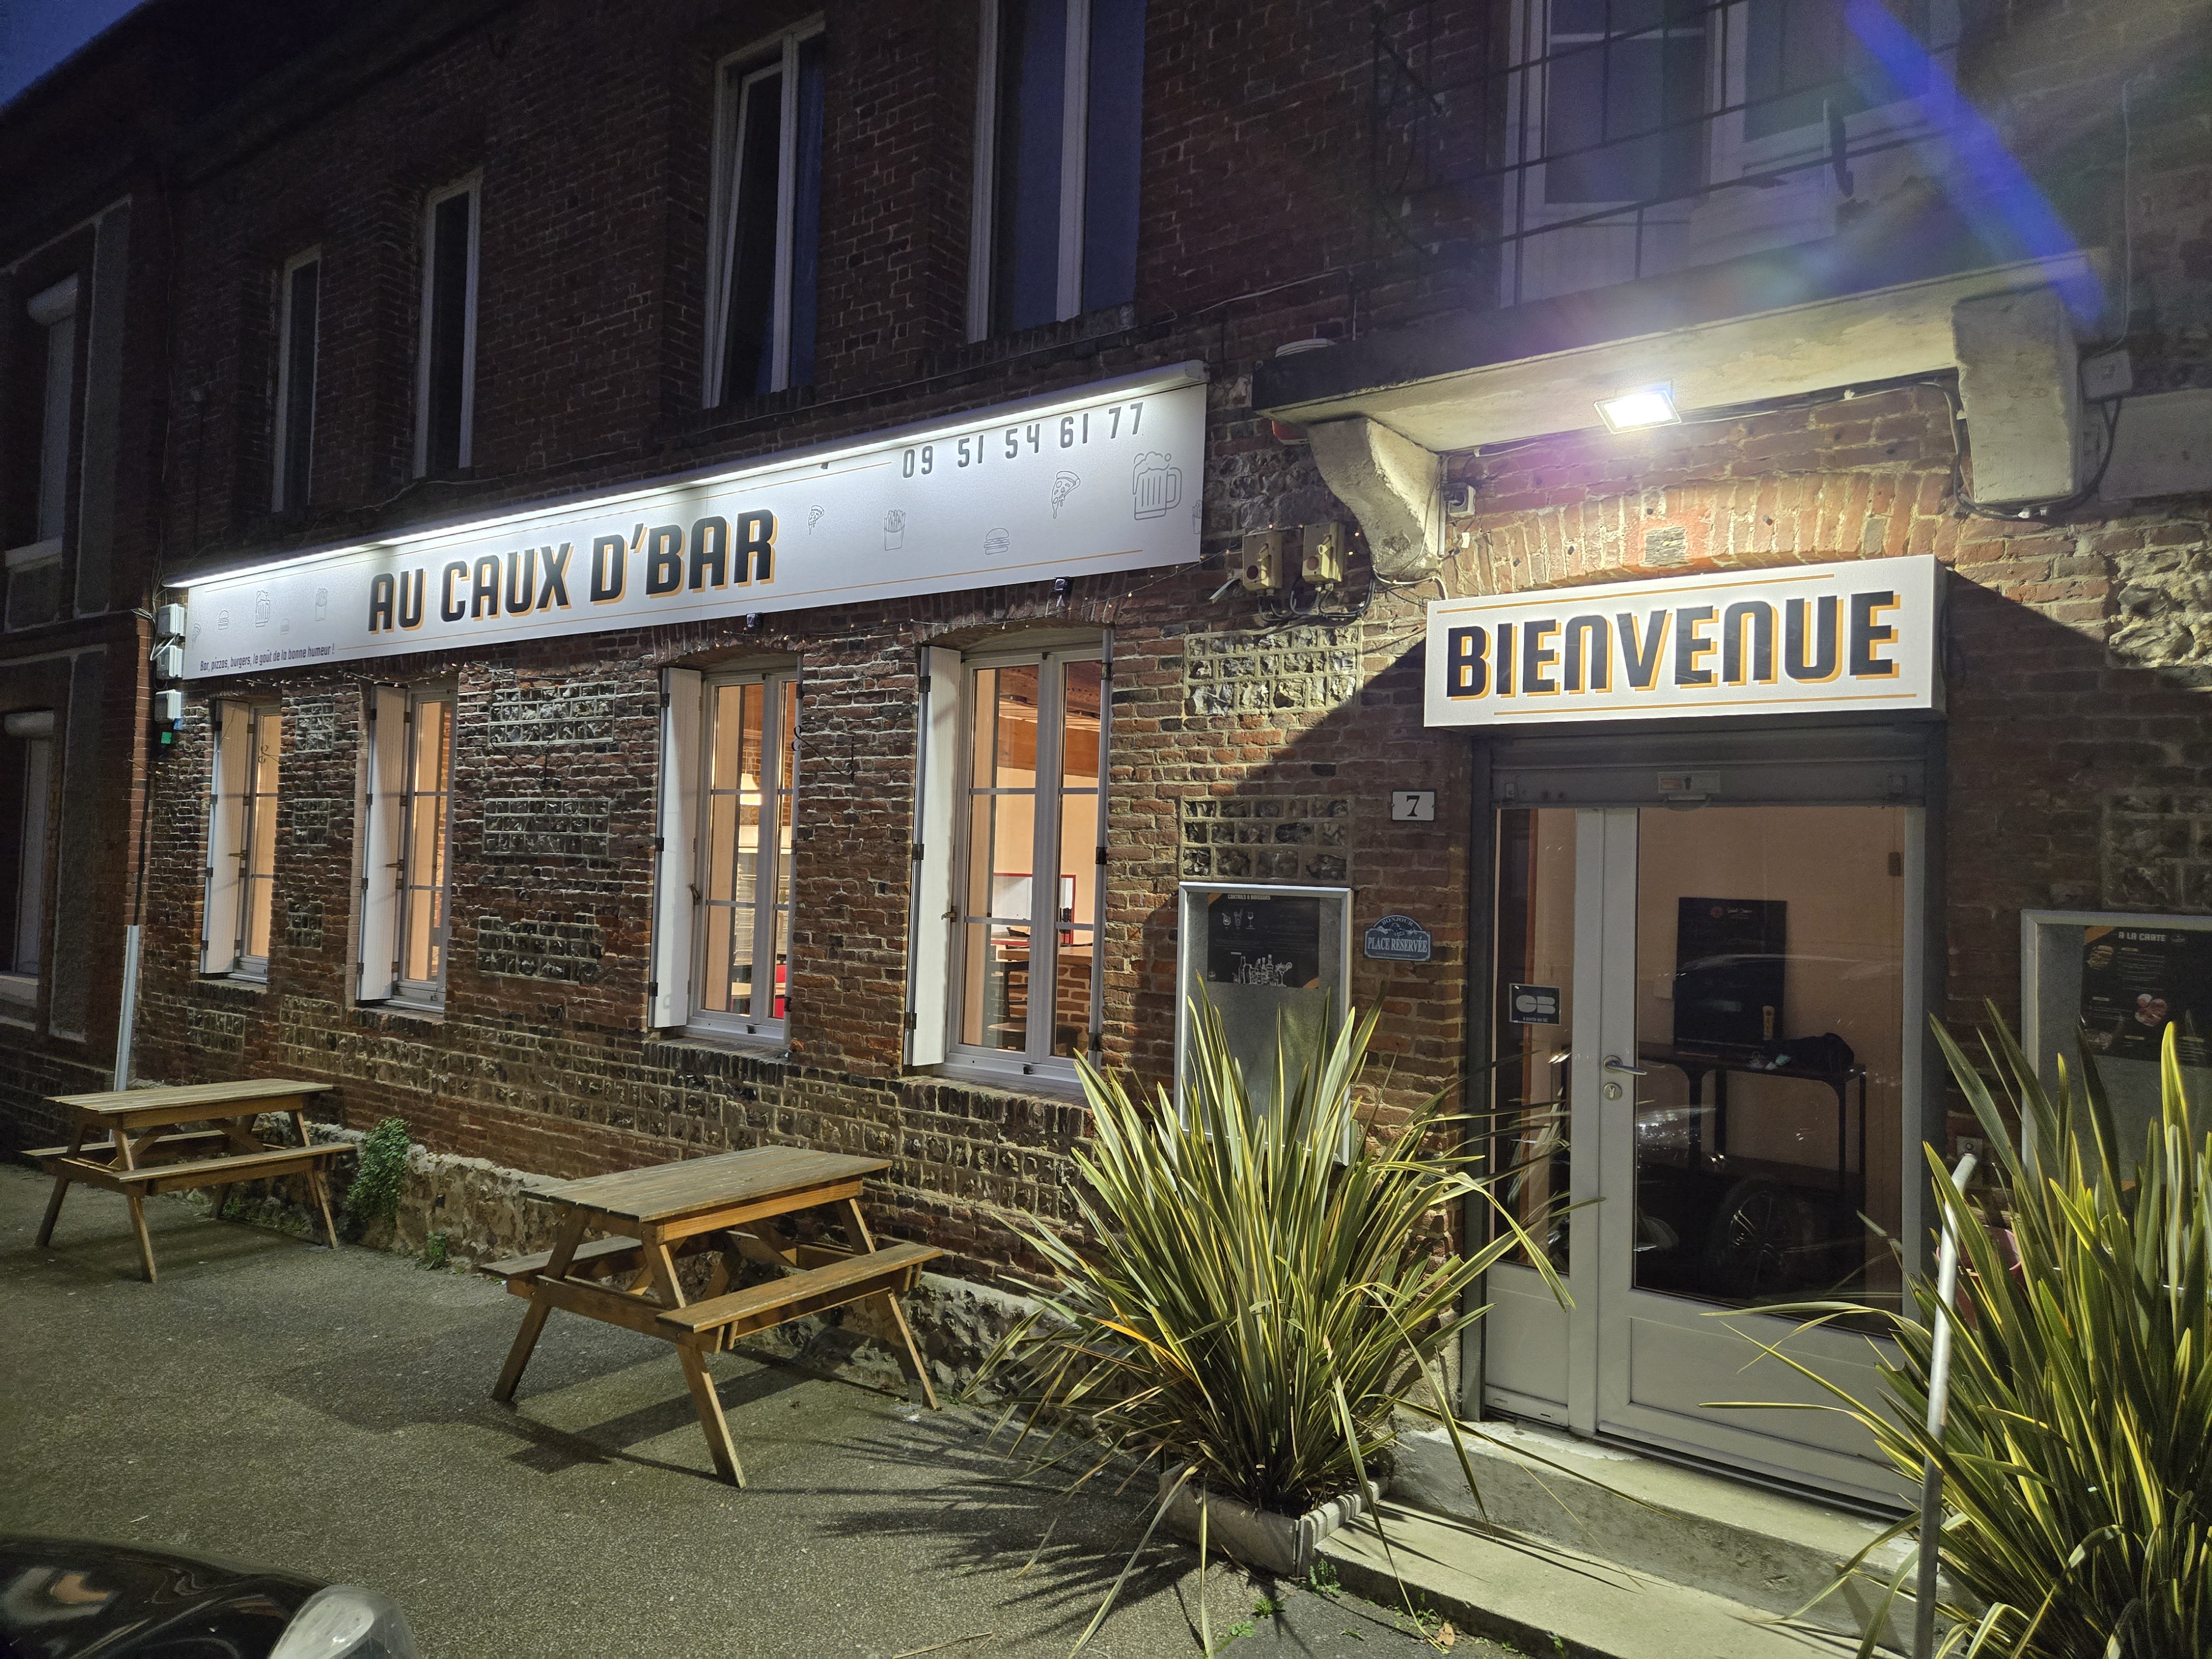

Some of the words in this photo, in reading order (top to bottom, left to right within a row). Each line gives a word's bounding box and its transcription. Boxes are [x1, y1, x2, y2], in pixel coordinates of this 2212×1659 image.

[902, 445, 933, 478] 09
[957, 435, 984, 467] 51
[1005, 424, 1040, 459] 54
[1060, 413, 1090, 448] 61
[1108, 402, 1144, 439] 77
[369, 568, 425, 635] AU
[441, 542, 573, 622] CAUX
[589, 509, 778, 606] D'BAR
[1447, 590, 1901, 701] BIENVENUE
[200, 660, 210, 672] Bar,
[211, 657, 229, 672] pizzas,
[231, 656, 252, 669] burgers,
[253, 653, 258, 664] le
[259, 649, 272, 666] goût
[273, 650, 280, 661] de
[281, 649, 287, 660] la
[288, 648, 306, 660] bonne
[307, 646, 331, 657] humeur
[1406, 795, 1421, 817] 7
[1382, 917, 1413, 927] BONJOUR
[1368, 937, 1390, 951] PLACE
[1391, 936, 1427, 953] RÉSERVÉE
